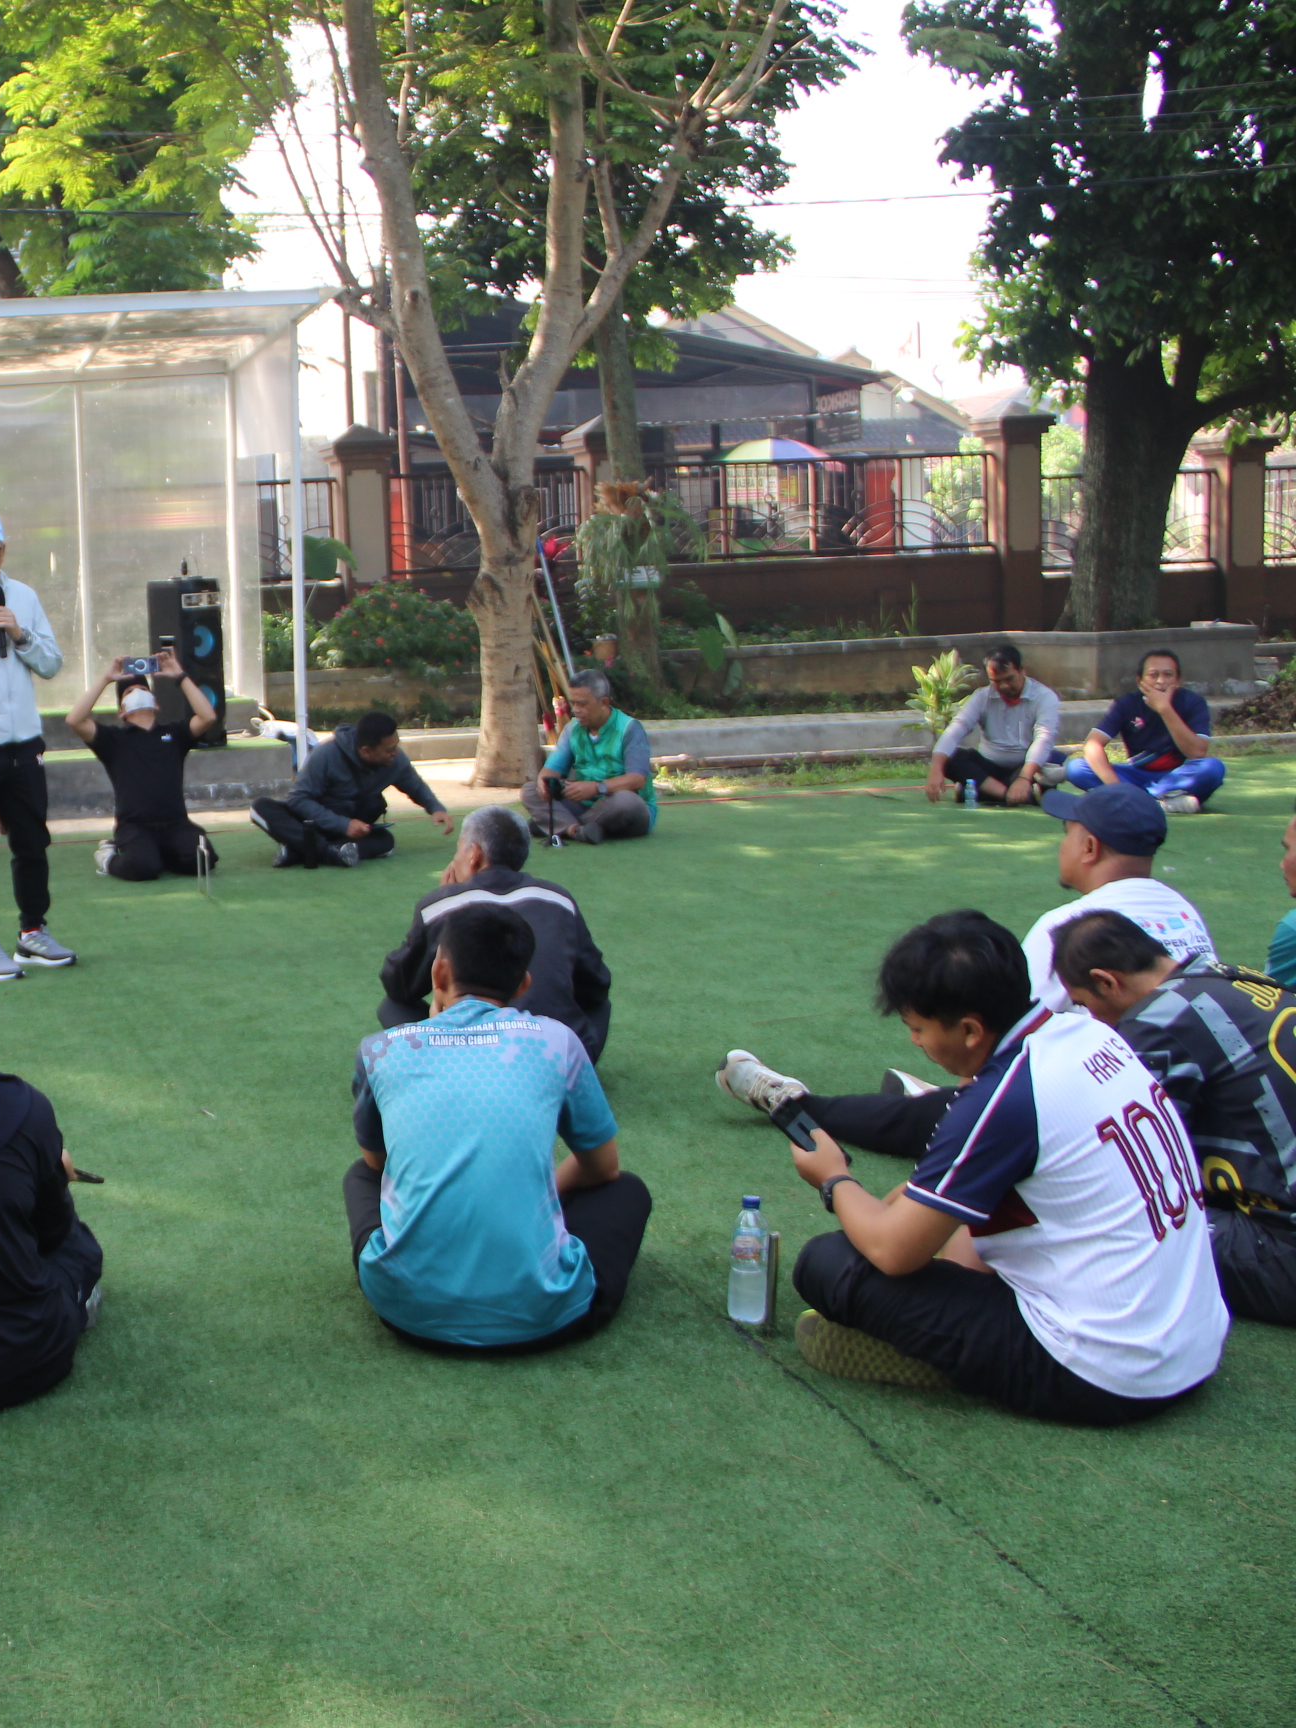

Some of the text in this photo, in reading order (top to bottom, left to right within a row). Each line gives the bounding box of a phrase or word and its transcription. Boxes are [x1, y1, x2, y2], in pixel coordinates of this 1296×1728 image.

[1161, 938, 1188, 948] PEN
[495, 1020, 542, 1032] INDONESIA
[428, 1034, 499, 1046] KAMPUS CIBIRU
[1082, 1037, 1133, 1085] HAN'S
